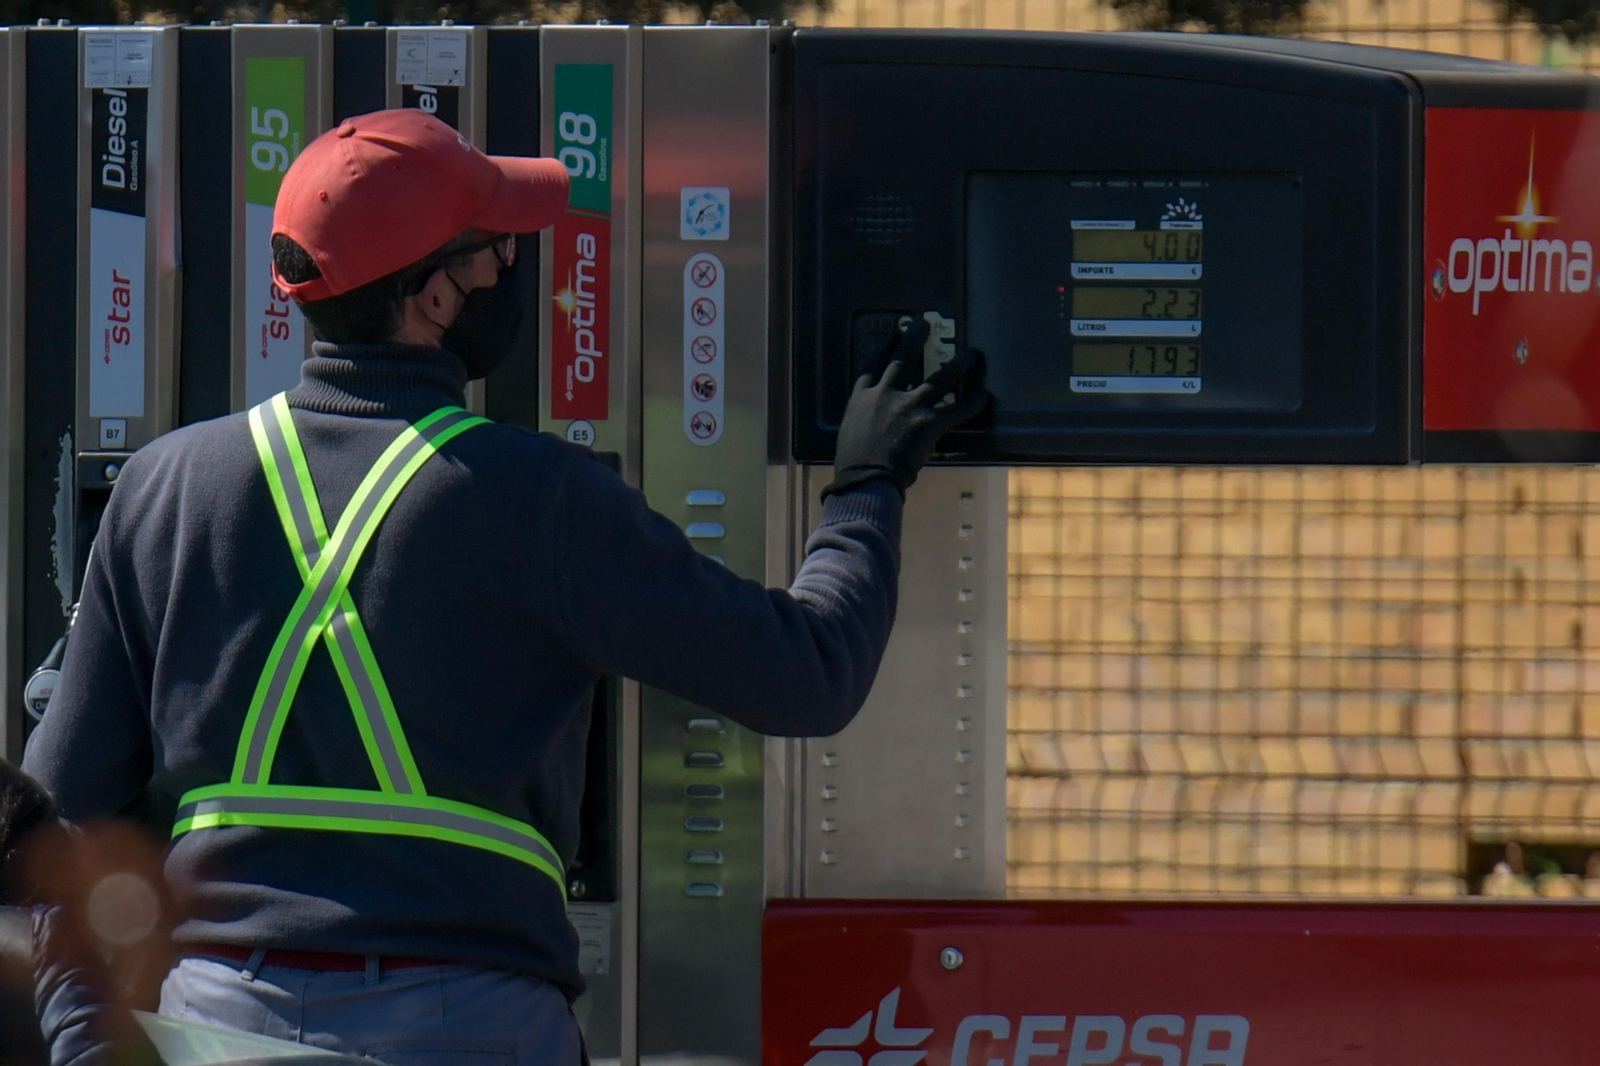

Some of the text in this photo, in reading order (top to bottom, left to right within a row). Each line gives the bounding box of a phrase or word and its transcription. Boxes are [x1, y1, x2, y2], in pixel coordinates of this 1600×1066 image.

[102, 88, 128, 189] Diesel
[251, 106, 289, 173] 95
[559, 111, 597, 179] 98
[598, 137, 607, 182] Gasolina
[1143, 232, 1200, 261] 4.00
[1078, 266, 1114, 274] IMPORTE
[1448, 228, 1592, 315] optima
[108, 269, 131, 345] star
[265, 263, 290, 341] sta
[572, 233, 603, 383] optima
[1142, 288, 1199, 318] 2.23
[1077, 323, 1197, 332] LITROS L
[1128, 345, 1199, 375] 1.793
[1076, 380, 1107, 388] PRECIO
[106, 429, 120, 439] B7
[573, 429, 588, 441] E5
[950, 1014, 1250, 1066] CEPSA
